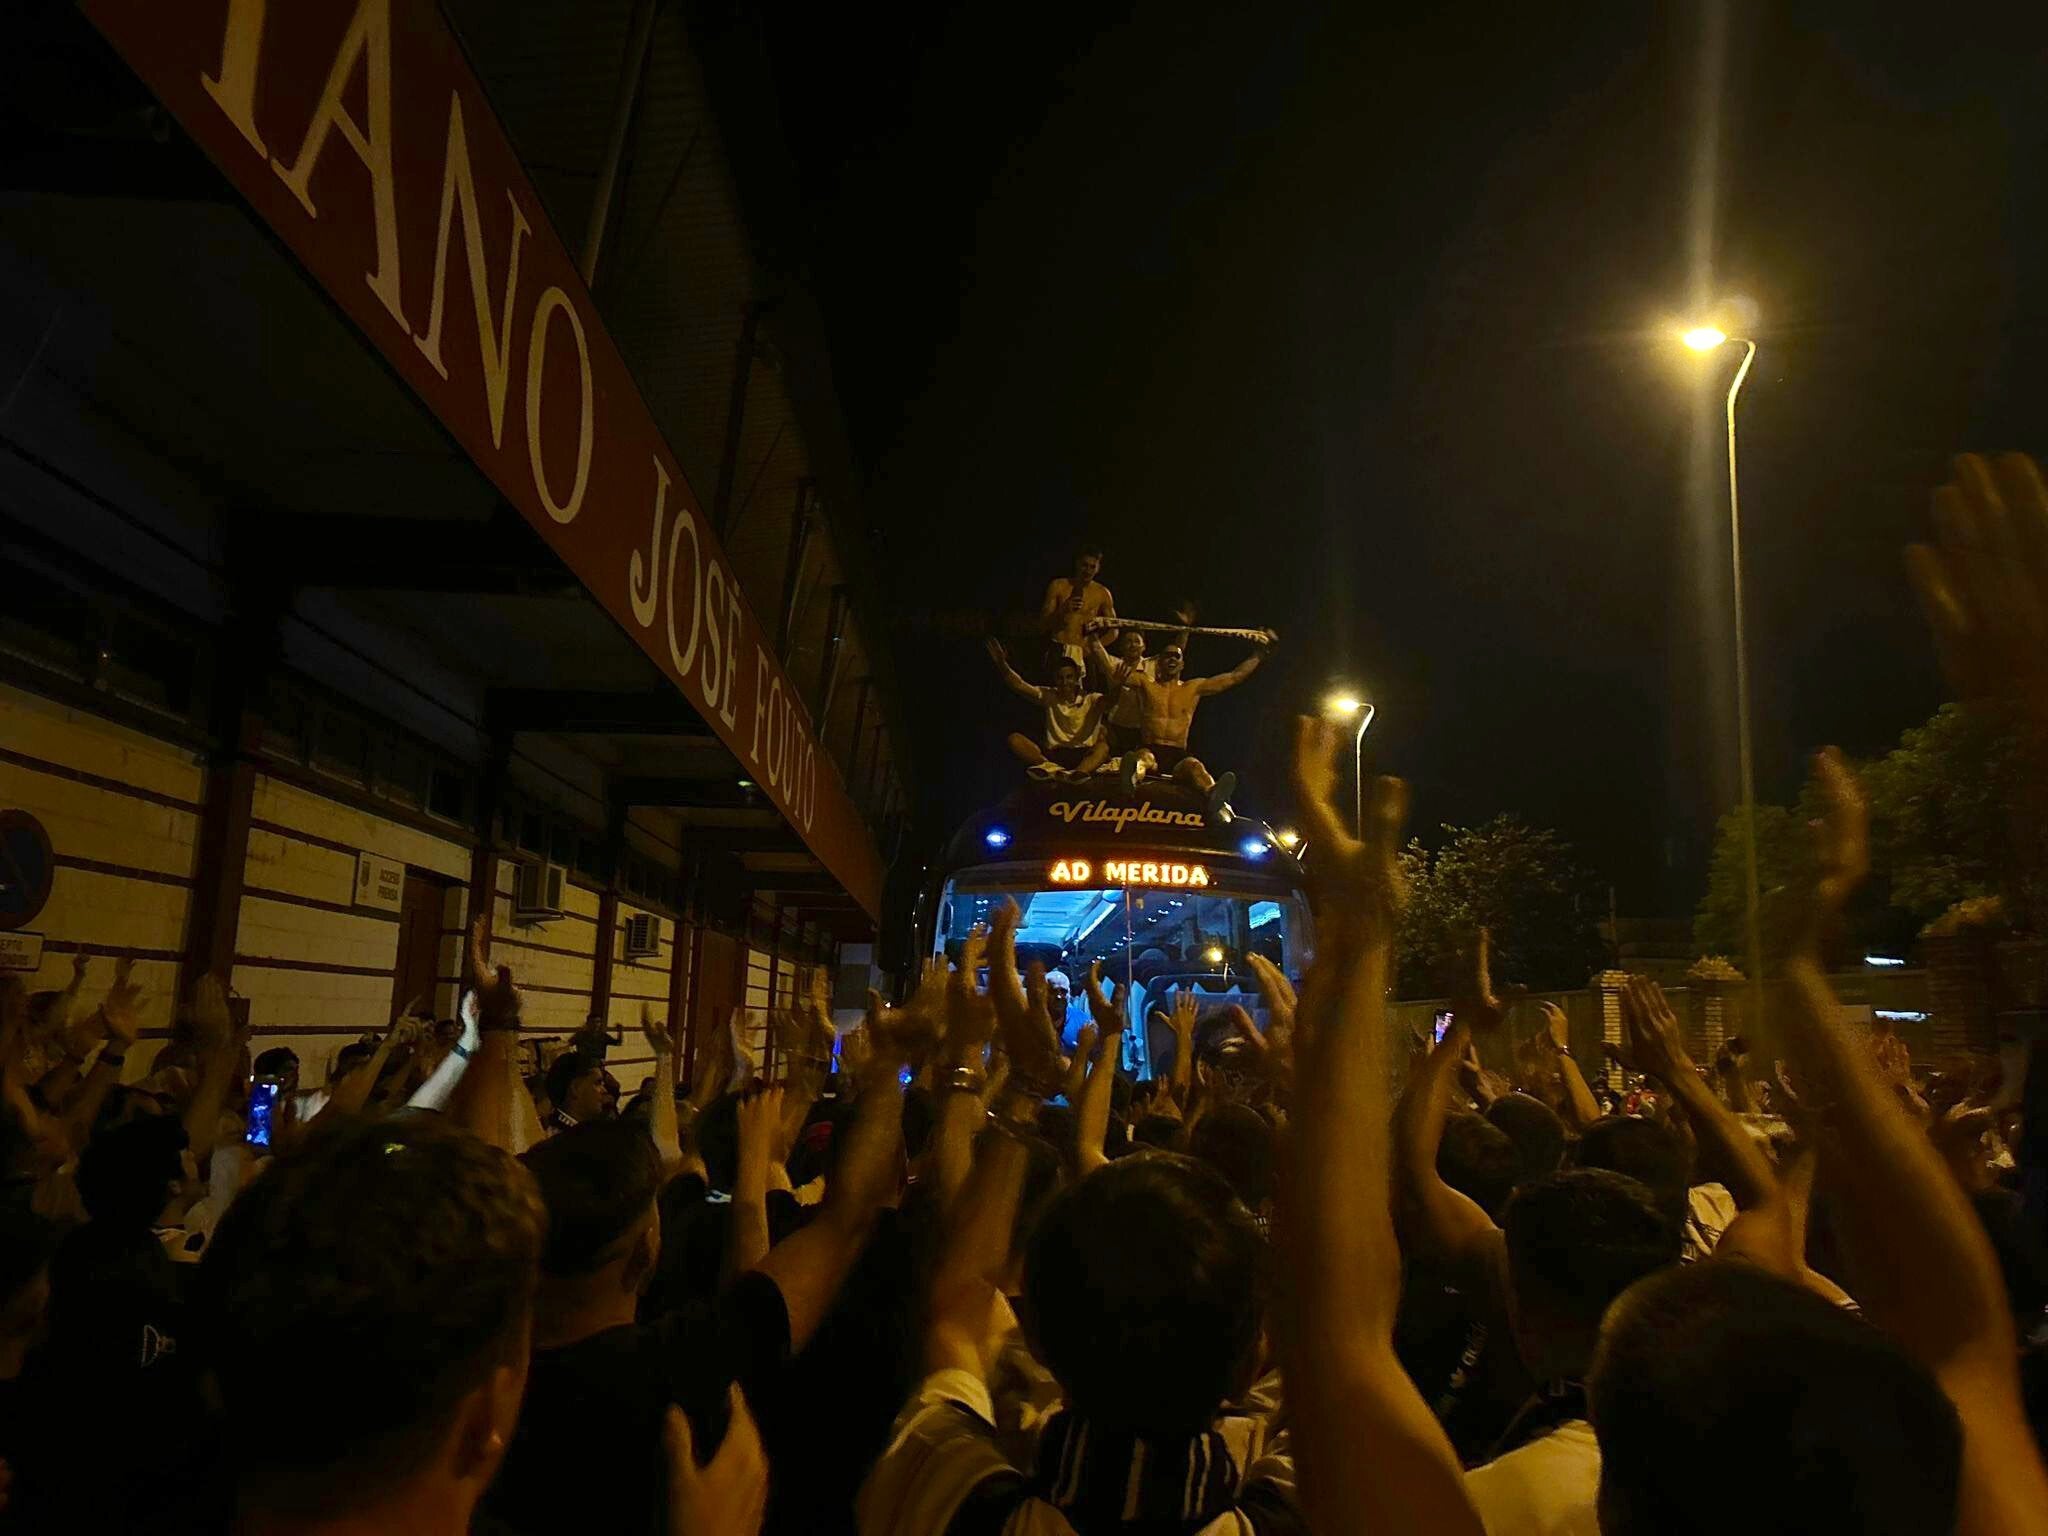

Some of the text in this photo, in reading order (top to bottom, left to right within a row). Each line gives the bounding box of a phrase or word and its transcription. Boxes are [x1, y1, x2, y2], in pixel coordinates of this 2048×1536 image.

[750, 642, 816, 834] FOUTO
[1049, 799, 1205, 833] Vilaplana
[1050, 859, 1210, 886] AD MERIDA
